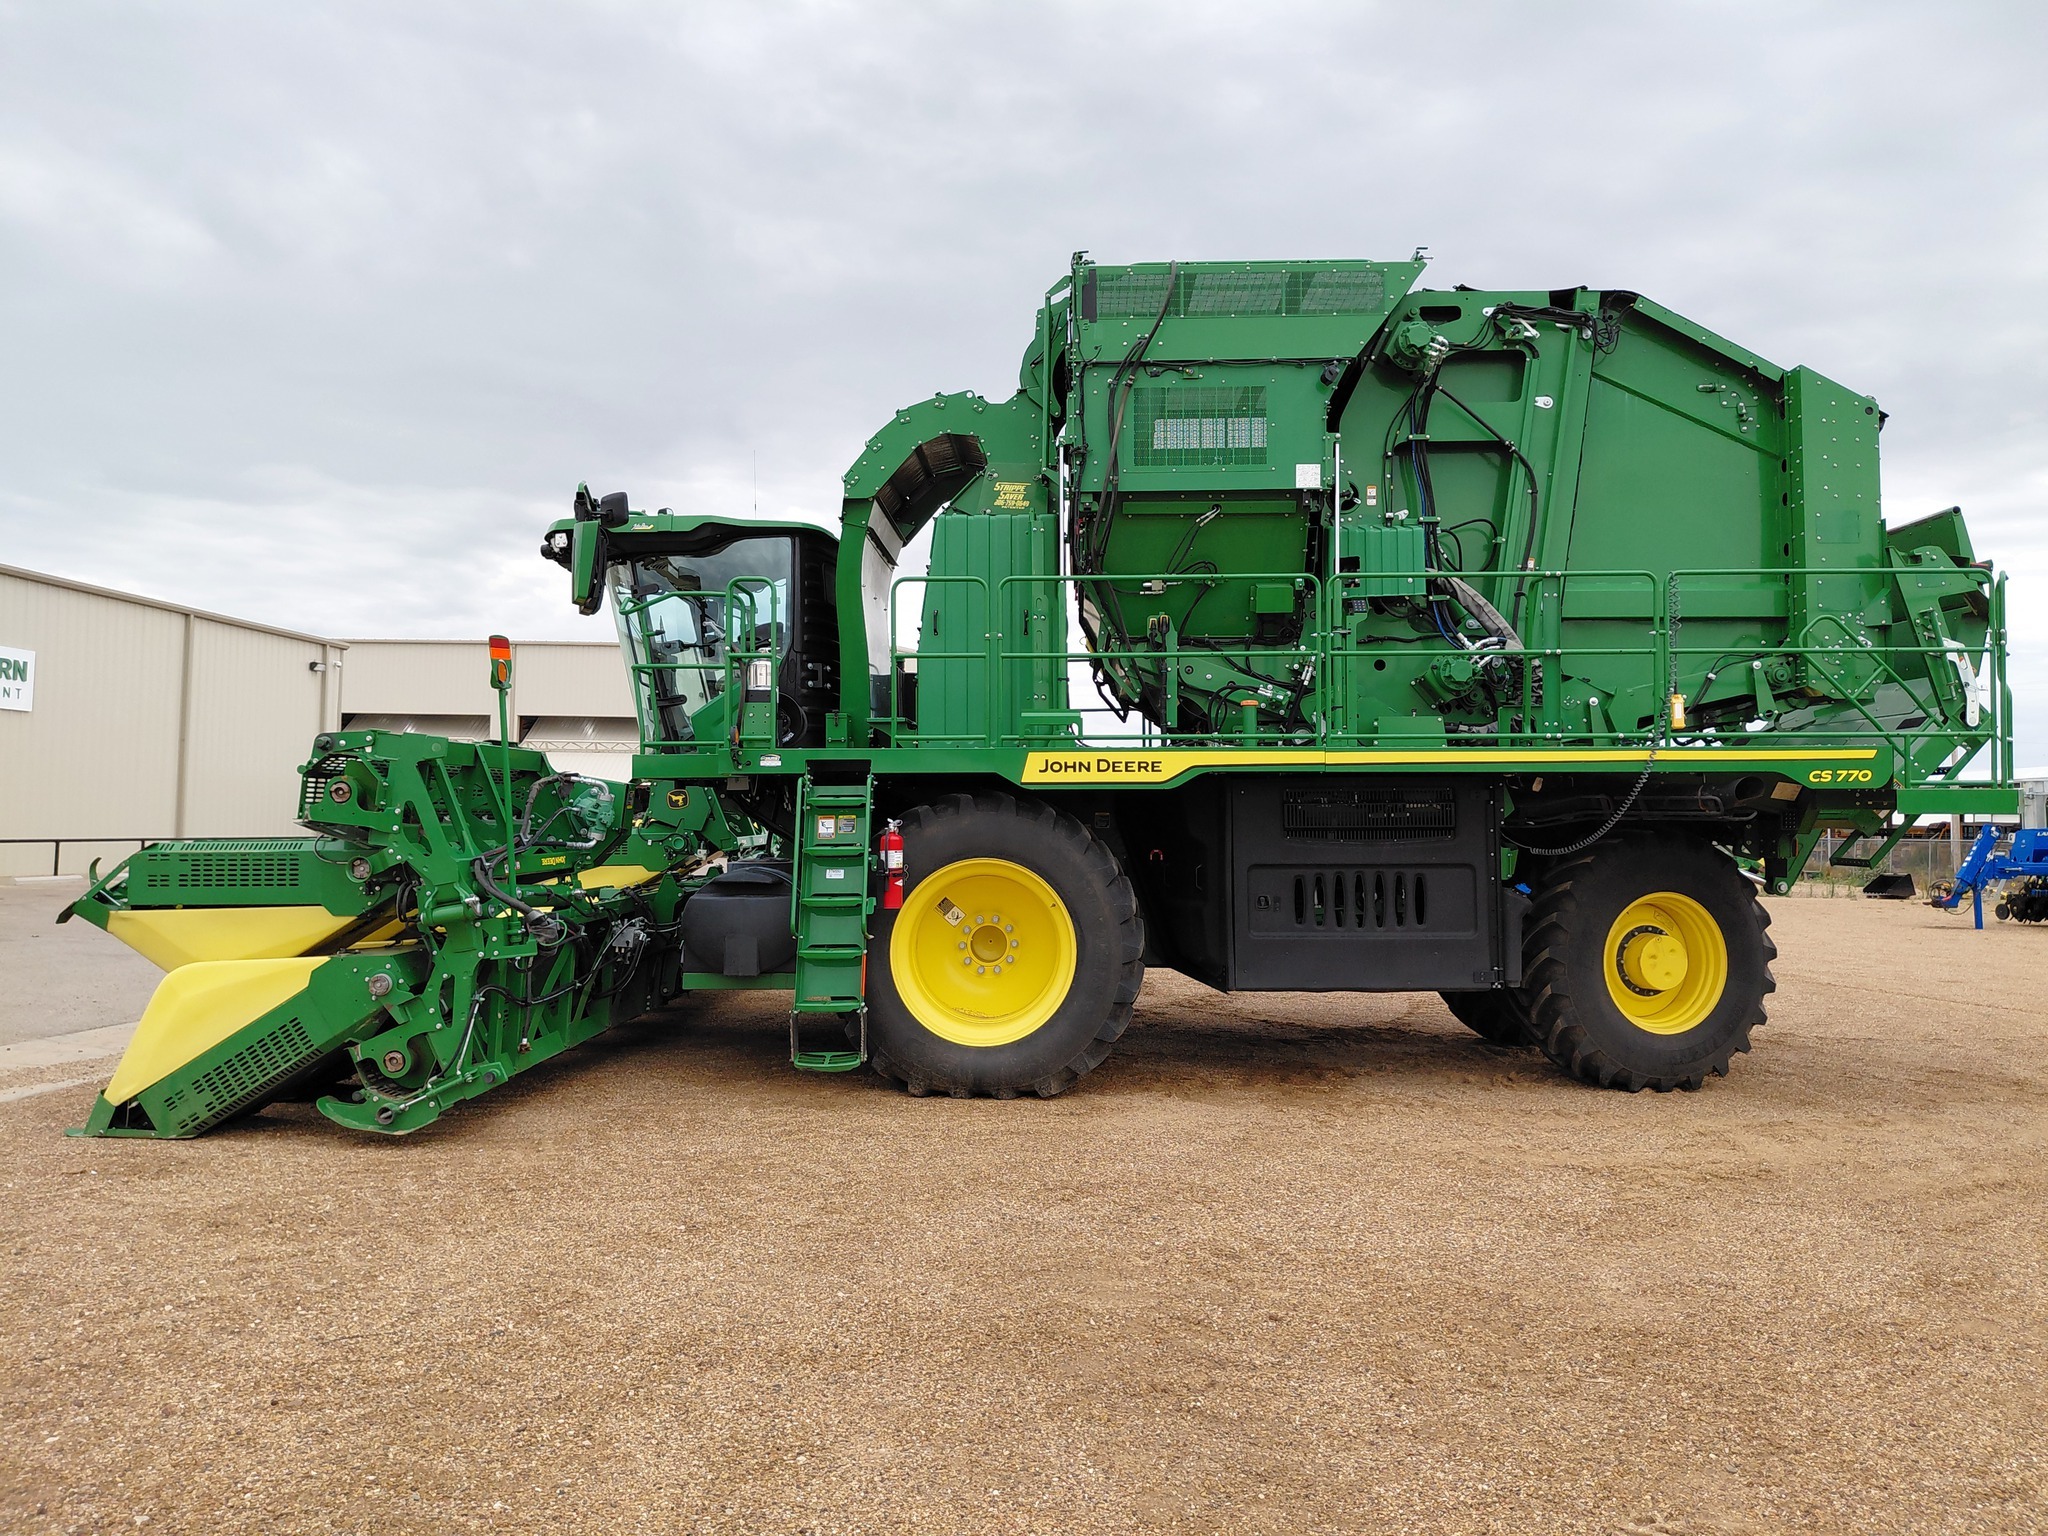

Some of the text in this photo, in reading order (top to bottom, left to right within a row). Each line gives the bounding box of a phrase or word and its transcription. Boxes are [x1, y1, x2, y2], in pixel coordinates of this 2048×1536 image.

[998, 491, 1026, 500] SAVER
[1039, 759, 1162, 773] JOHN DEERE
[1809, 769, 1872, 782] CS 770
